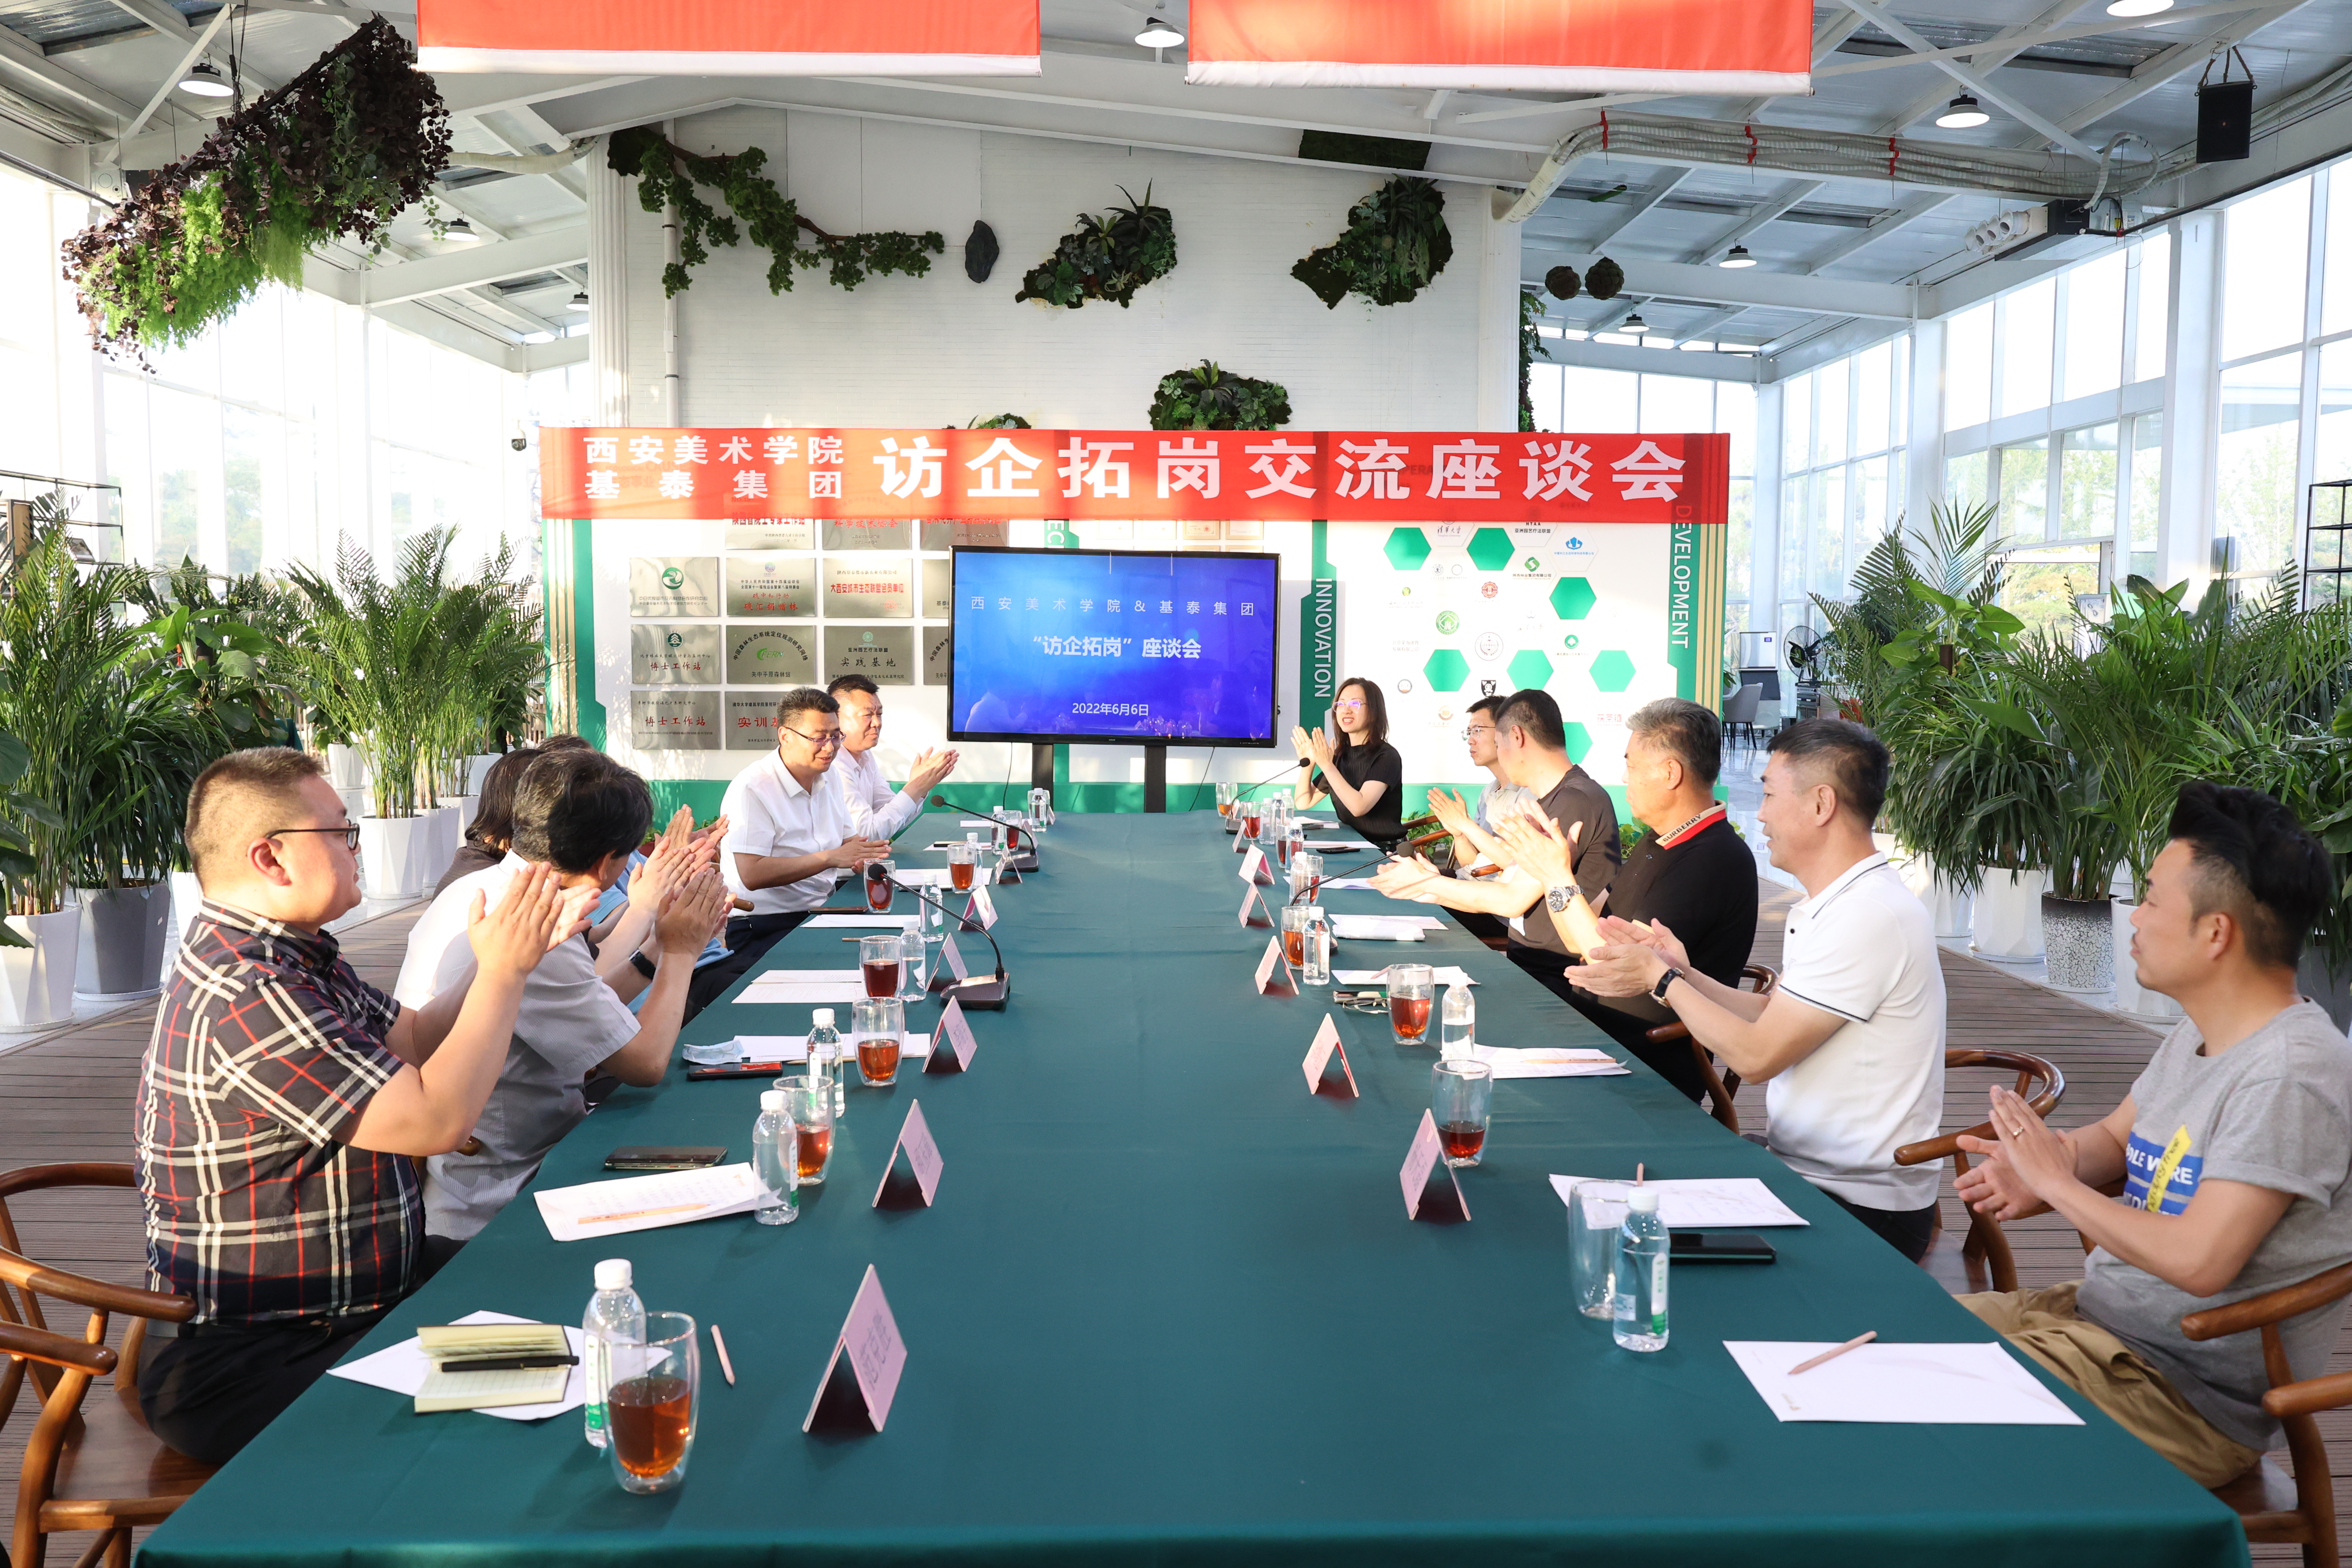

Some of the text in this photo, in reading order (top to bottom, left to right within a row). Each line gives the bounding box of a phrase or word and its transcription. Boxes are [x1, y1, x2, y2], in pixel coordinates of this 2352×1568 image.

[583, 435, 844, 464] 西安美术学院
[873, 435, 1686, 502] 访企拓岗交流座谈会
[585, 470, 842, 499] 基泰集团
[1314, 578, 1332, 697] INNOVATION
[650, 662, 701, 671] 博士工作站
[840, 656, 896, 668] 实践基地
[1072, 702, 1149, 717] 2022年6月6日
[645, 716, 706, 727] 博士工作站
